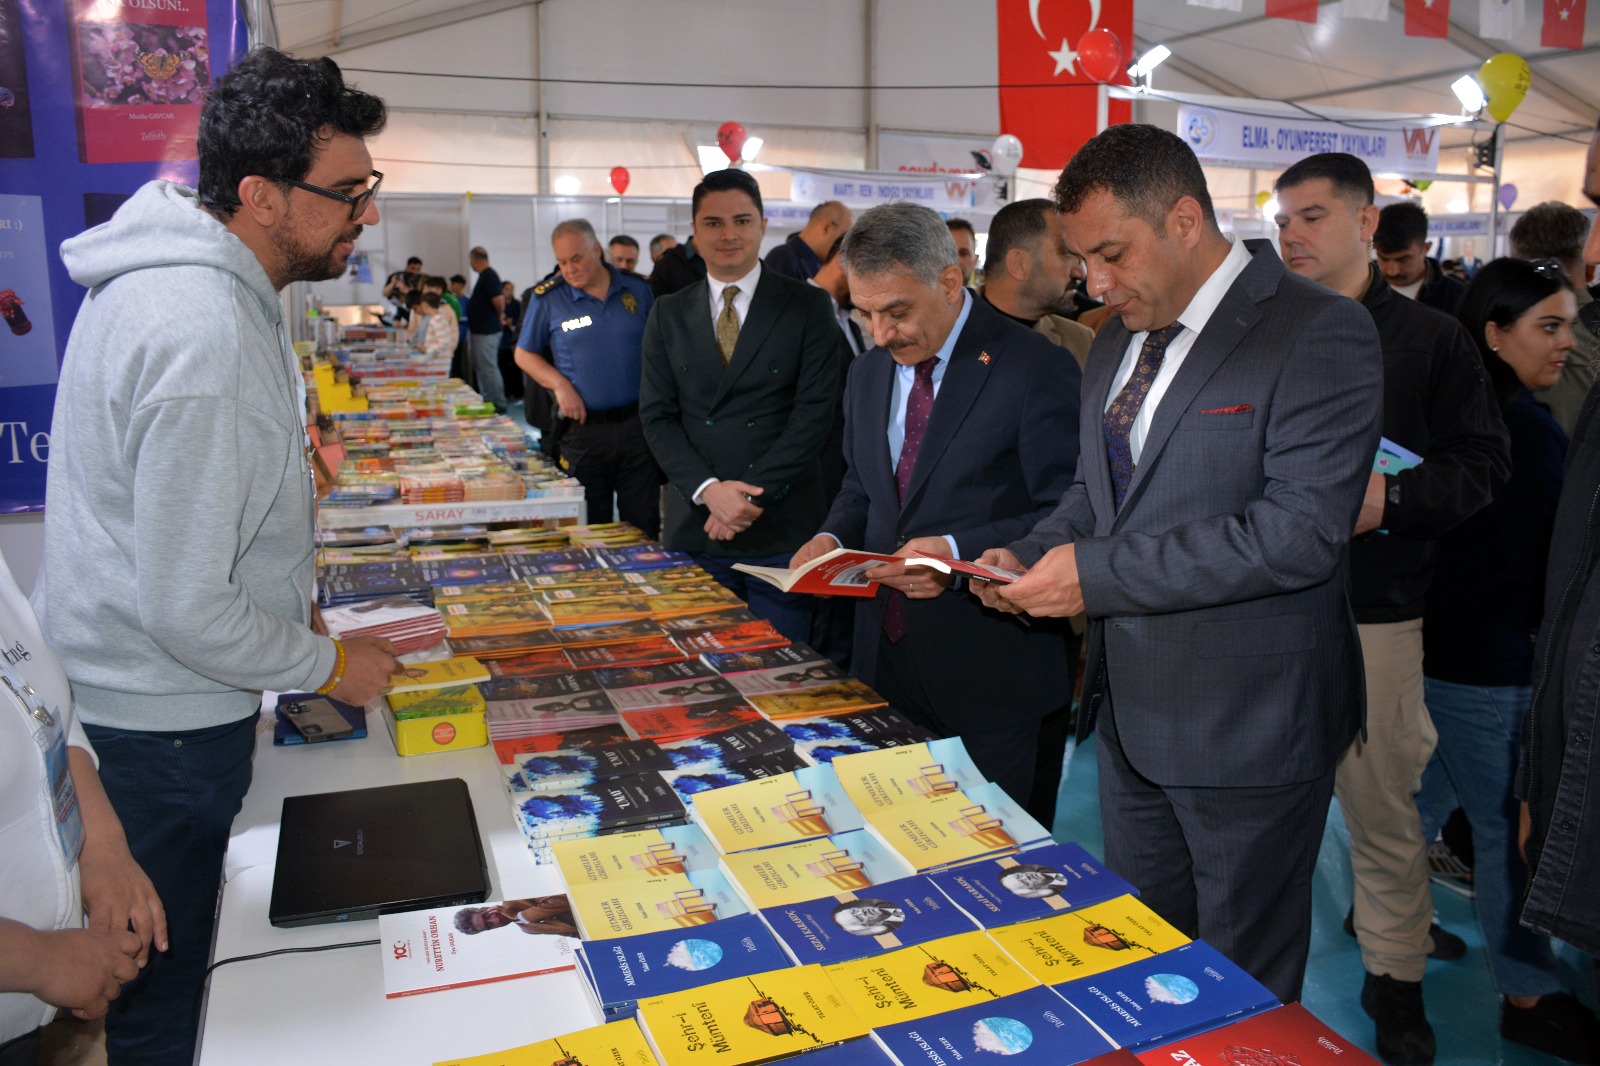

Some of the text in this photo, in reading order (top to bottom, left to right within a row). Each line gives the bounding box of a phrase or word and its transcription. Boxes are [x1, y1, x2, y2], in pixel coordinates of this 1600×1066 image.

[1243, 126, 1387, 158] ELMA OYUNPEREST YAYINLARI
[415, 509, 465, 522] SARAY
[861, 776, 884, 807] GİTMELER
[722, 807, 743, 835] GİTMELER
[899, 823, 928, 851] GİTMELER
[579, 853, 598, 881] GİTMELER
[753, 864, 777, 891] GİTMELER
[600, 901, 621, 932] GİTMELER
[978, 896, 1001, 913] SEZAİ
[428, 915, 445, 972] NURETTİN ORHAN
[804, 932, 826, 951] SEZAİ
[1021, 938, 1059, 968] Şehr-i
[613, 945, 636, 986] MİMESİS ISLAĞI
[972, 953, 986, 965] ÖZER
[983, 963, 998, 977] TALAT
[803, 991, 825, 1020] TALAT ÖZER
[855, 976, 891, 1009] Şehr-i
[1087, 985, 1142, 1028] MİMESİS ISLAĞI
[1116, 990, 1131, 1002] ÖZER
[672, 1013, 704, 1052] Şehr-i
[908, 1031, 931, 1052] ISLAĞI
[939, 1037, 954, 1049] ÖZER
